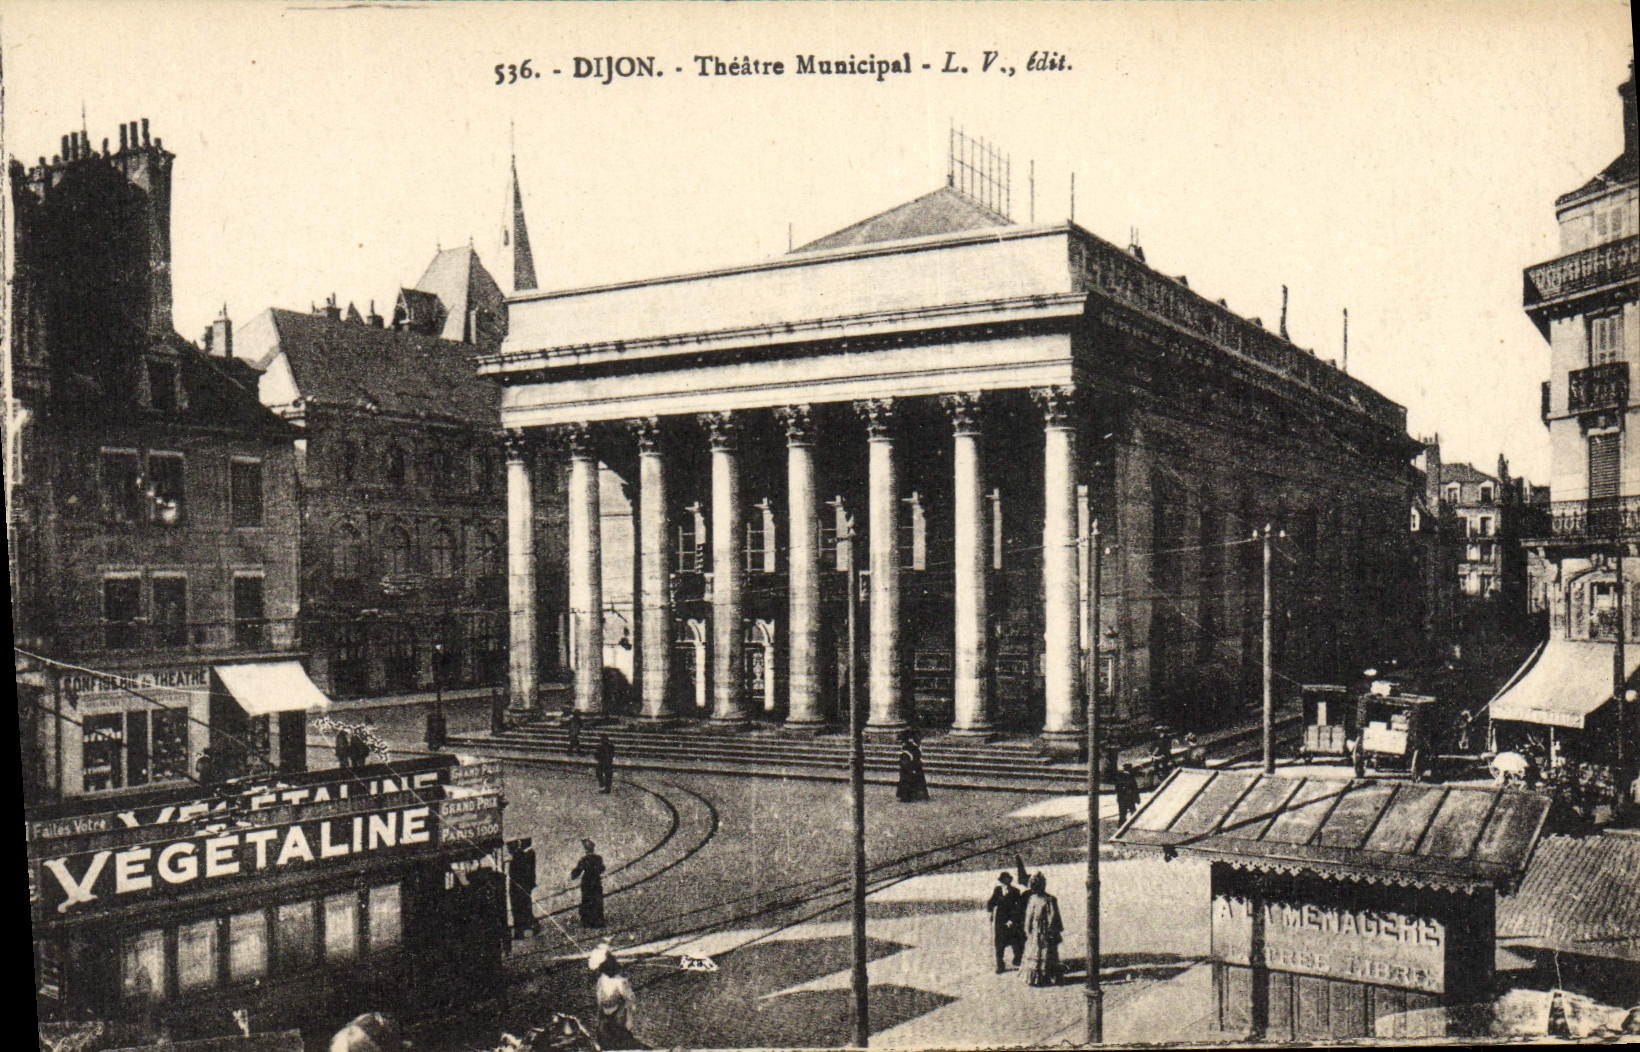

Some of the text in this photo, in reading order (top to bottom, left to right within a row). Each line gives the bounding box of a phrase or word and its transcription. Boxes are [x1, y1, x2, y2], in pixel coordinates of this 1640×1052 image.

[442, 796, 498, 815] GRAND PRIX
[73, 819, 106, 834] Votre
[442, 828, 474, 843] PARIS
[43, 806, 431, 913] VÉGÉTALINE
